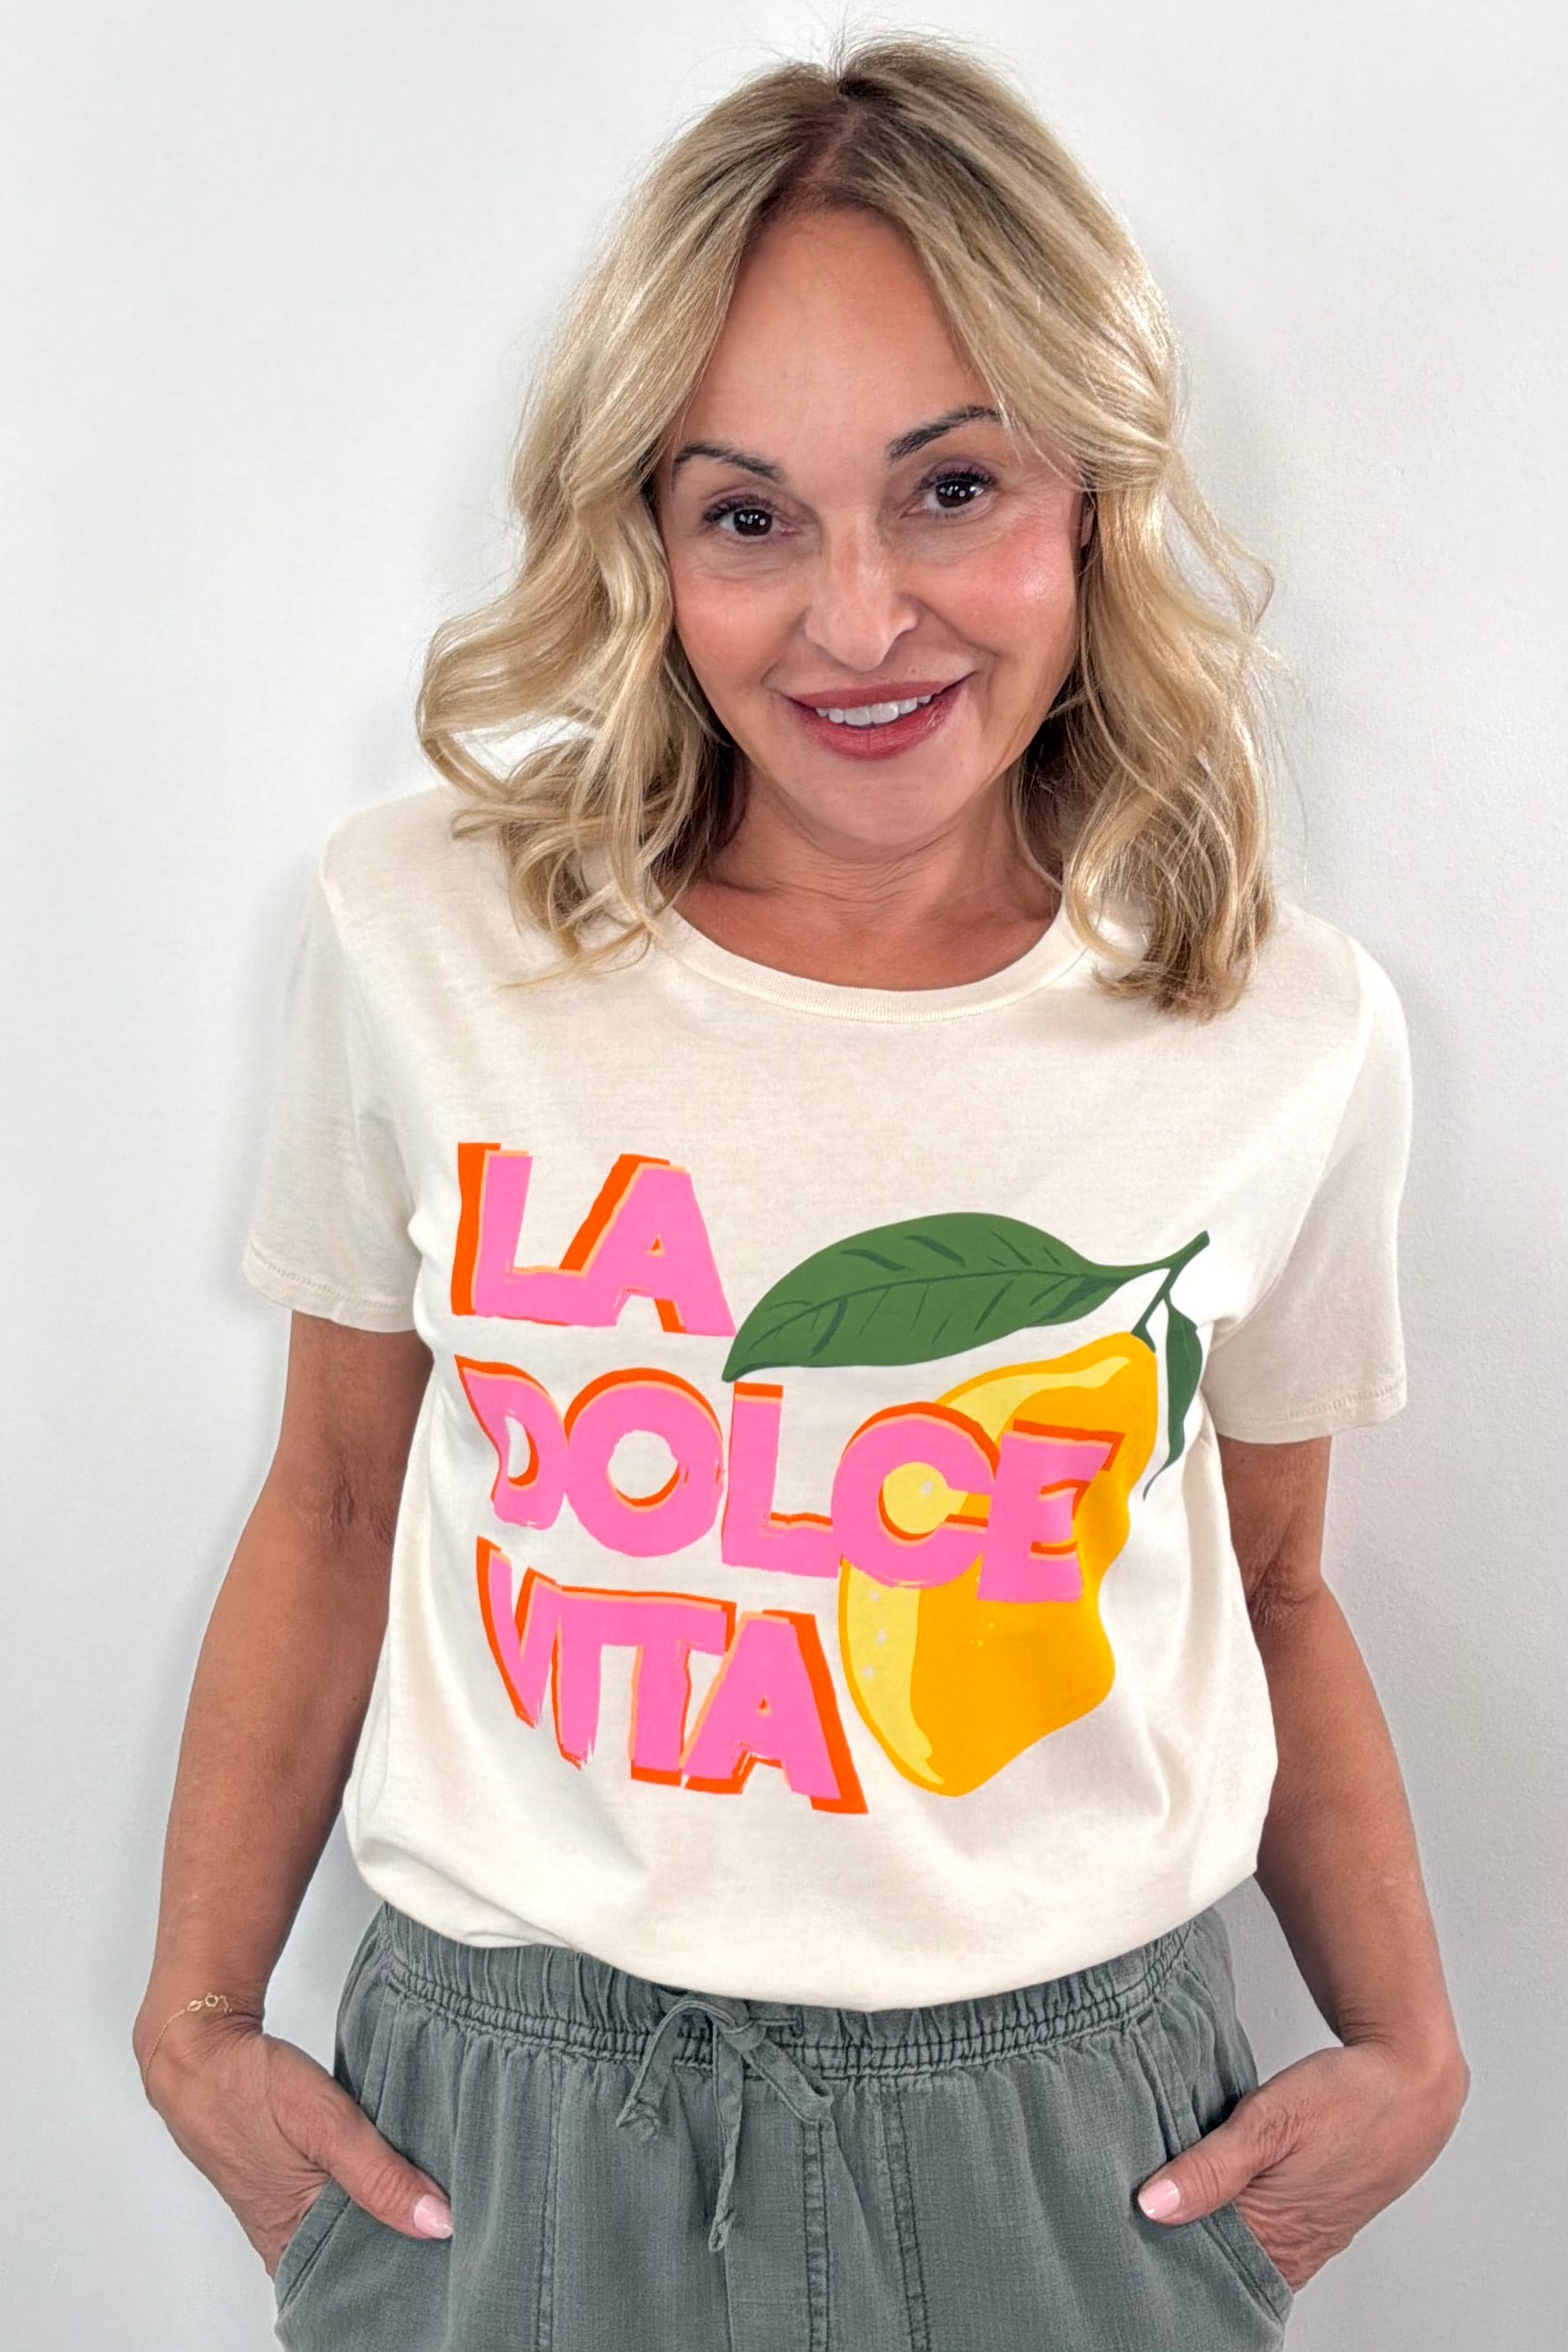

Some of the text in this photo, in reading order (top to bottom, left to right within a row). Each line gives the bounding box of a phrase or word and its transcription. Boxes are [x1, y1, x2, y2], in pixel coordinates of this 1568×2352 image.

[451, 1142, 735, 1336] LA
[454, 1354, 1123, 1604] DOLCE
[475, 1536, 868, 1815] VITA
